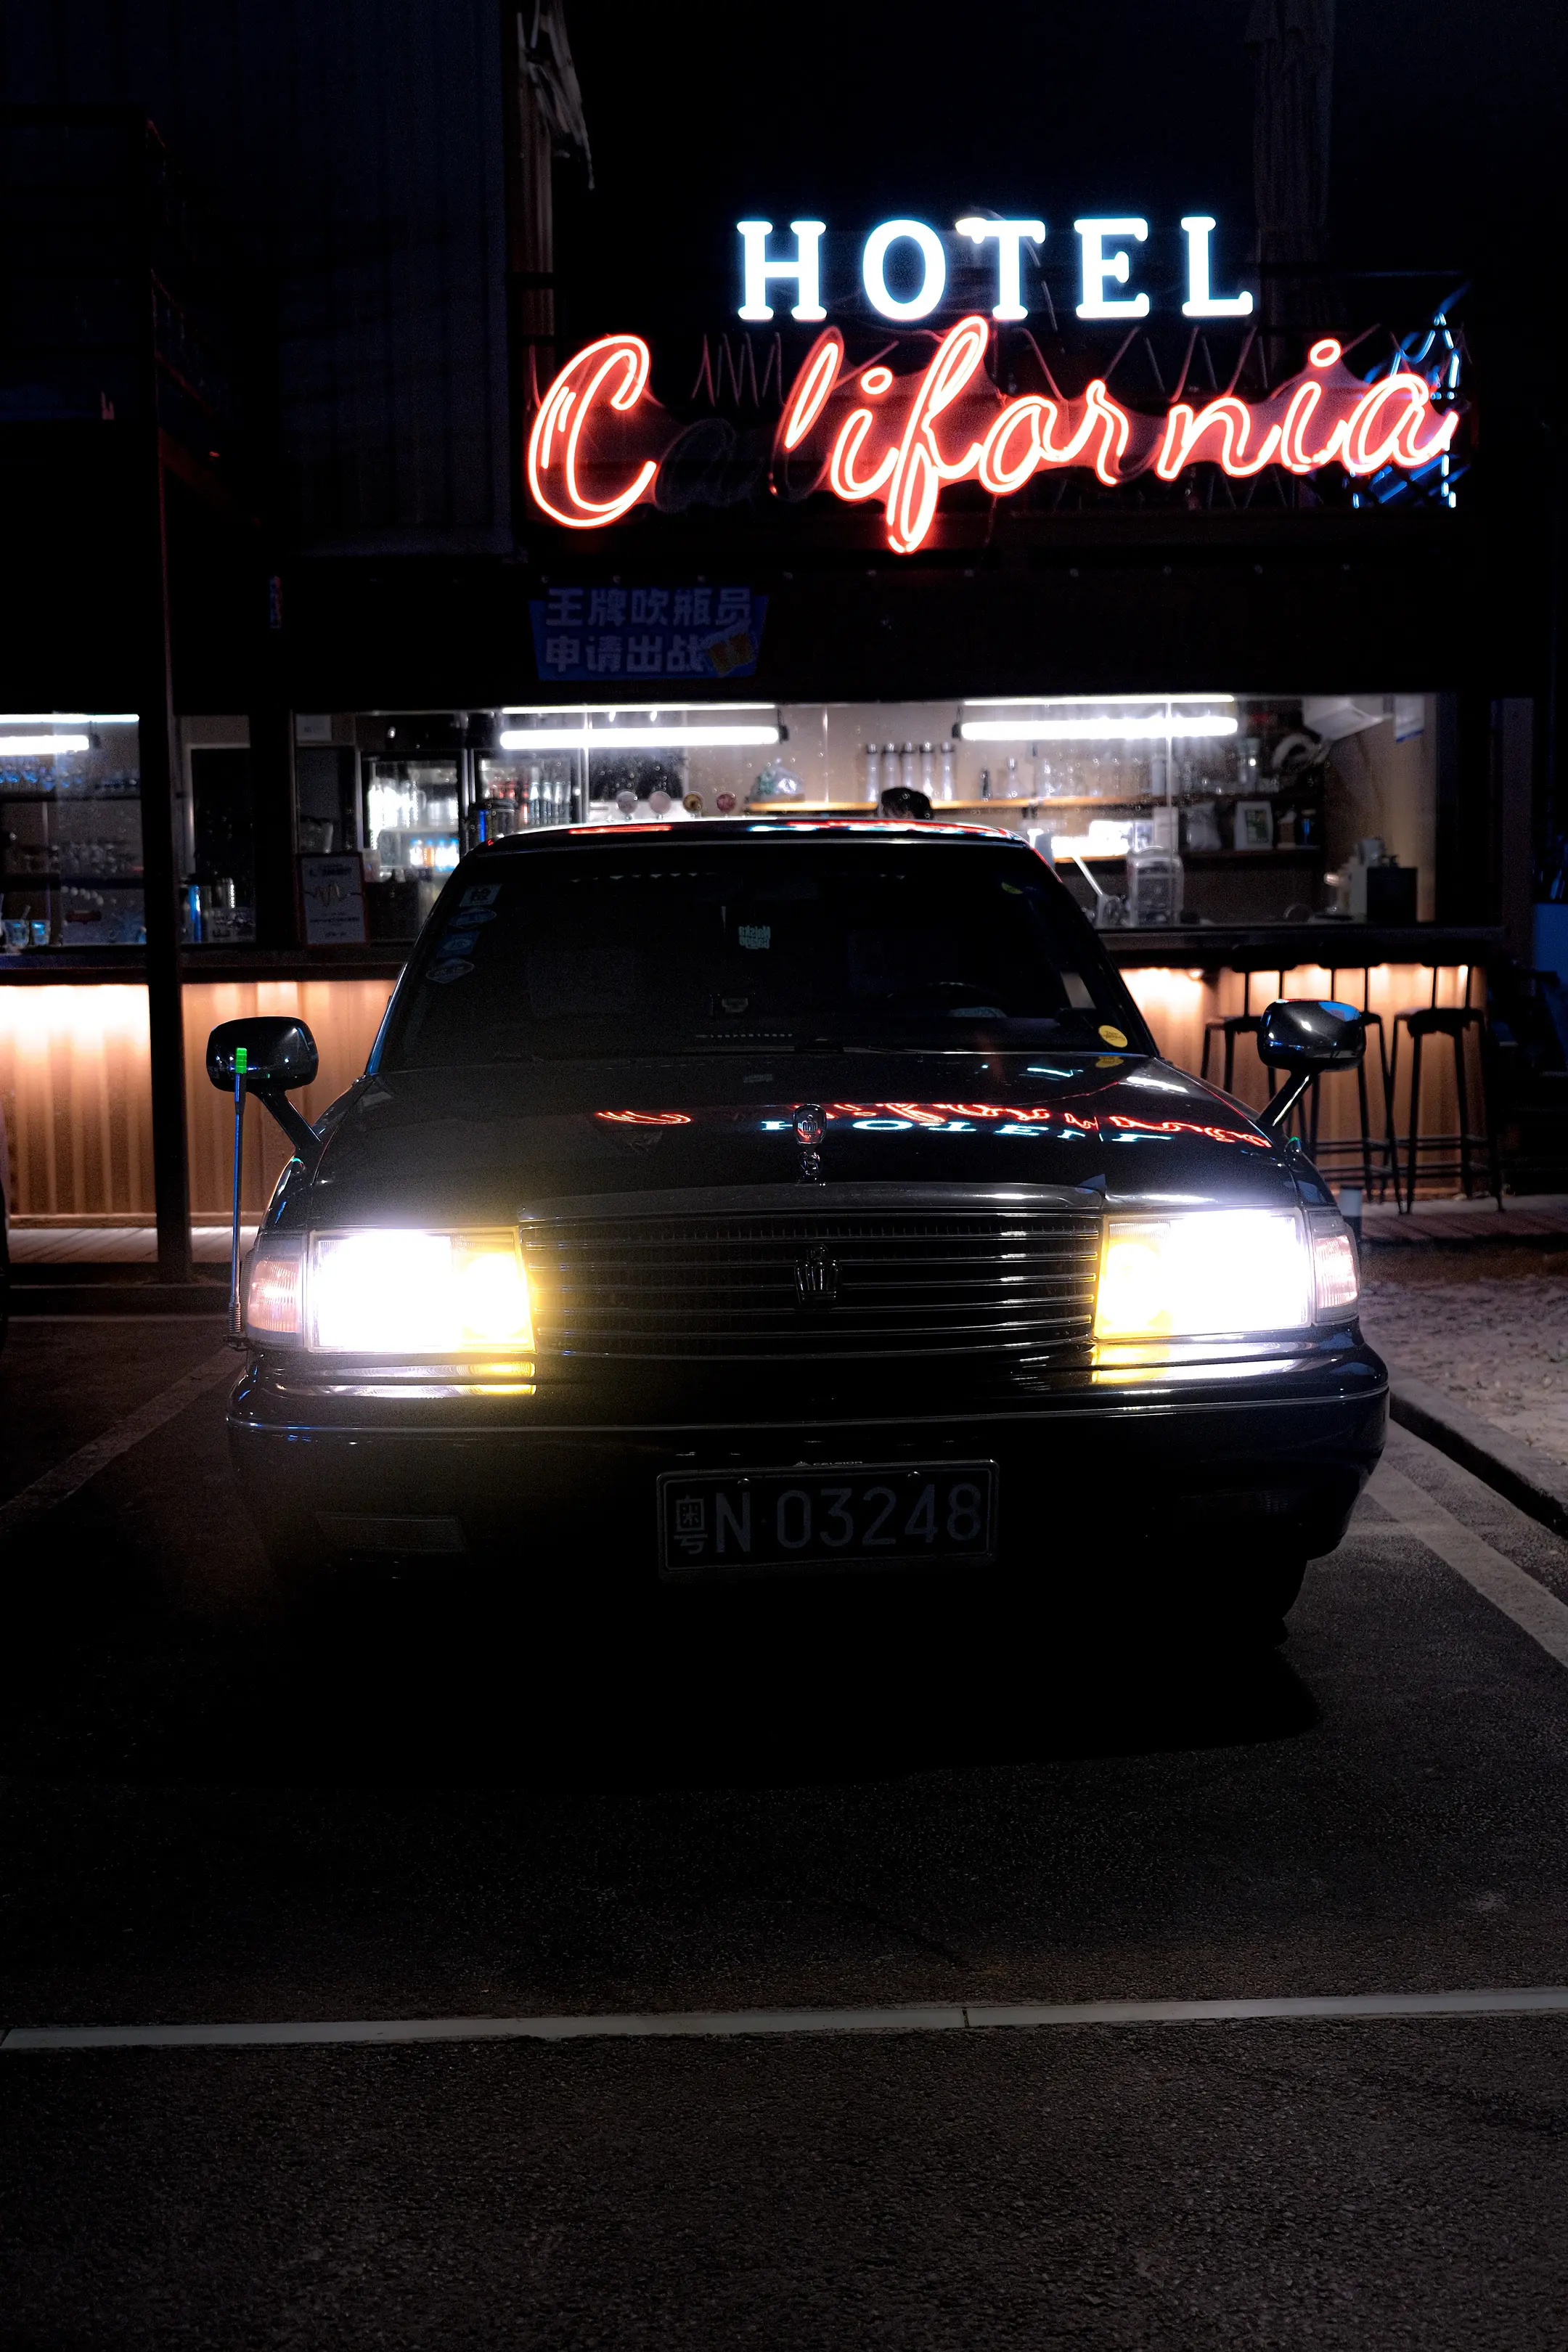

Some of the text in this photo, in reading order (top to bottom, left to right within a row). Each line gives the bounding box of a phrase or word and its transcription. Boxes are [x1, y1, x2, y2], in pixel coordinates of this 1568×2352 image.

[735, 216, 1254, 321] HOTEL
[546, 587, 752, 627] 王牌吹瓶员
[545, 634, 706, 674] 申请出战
